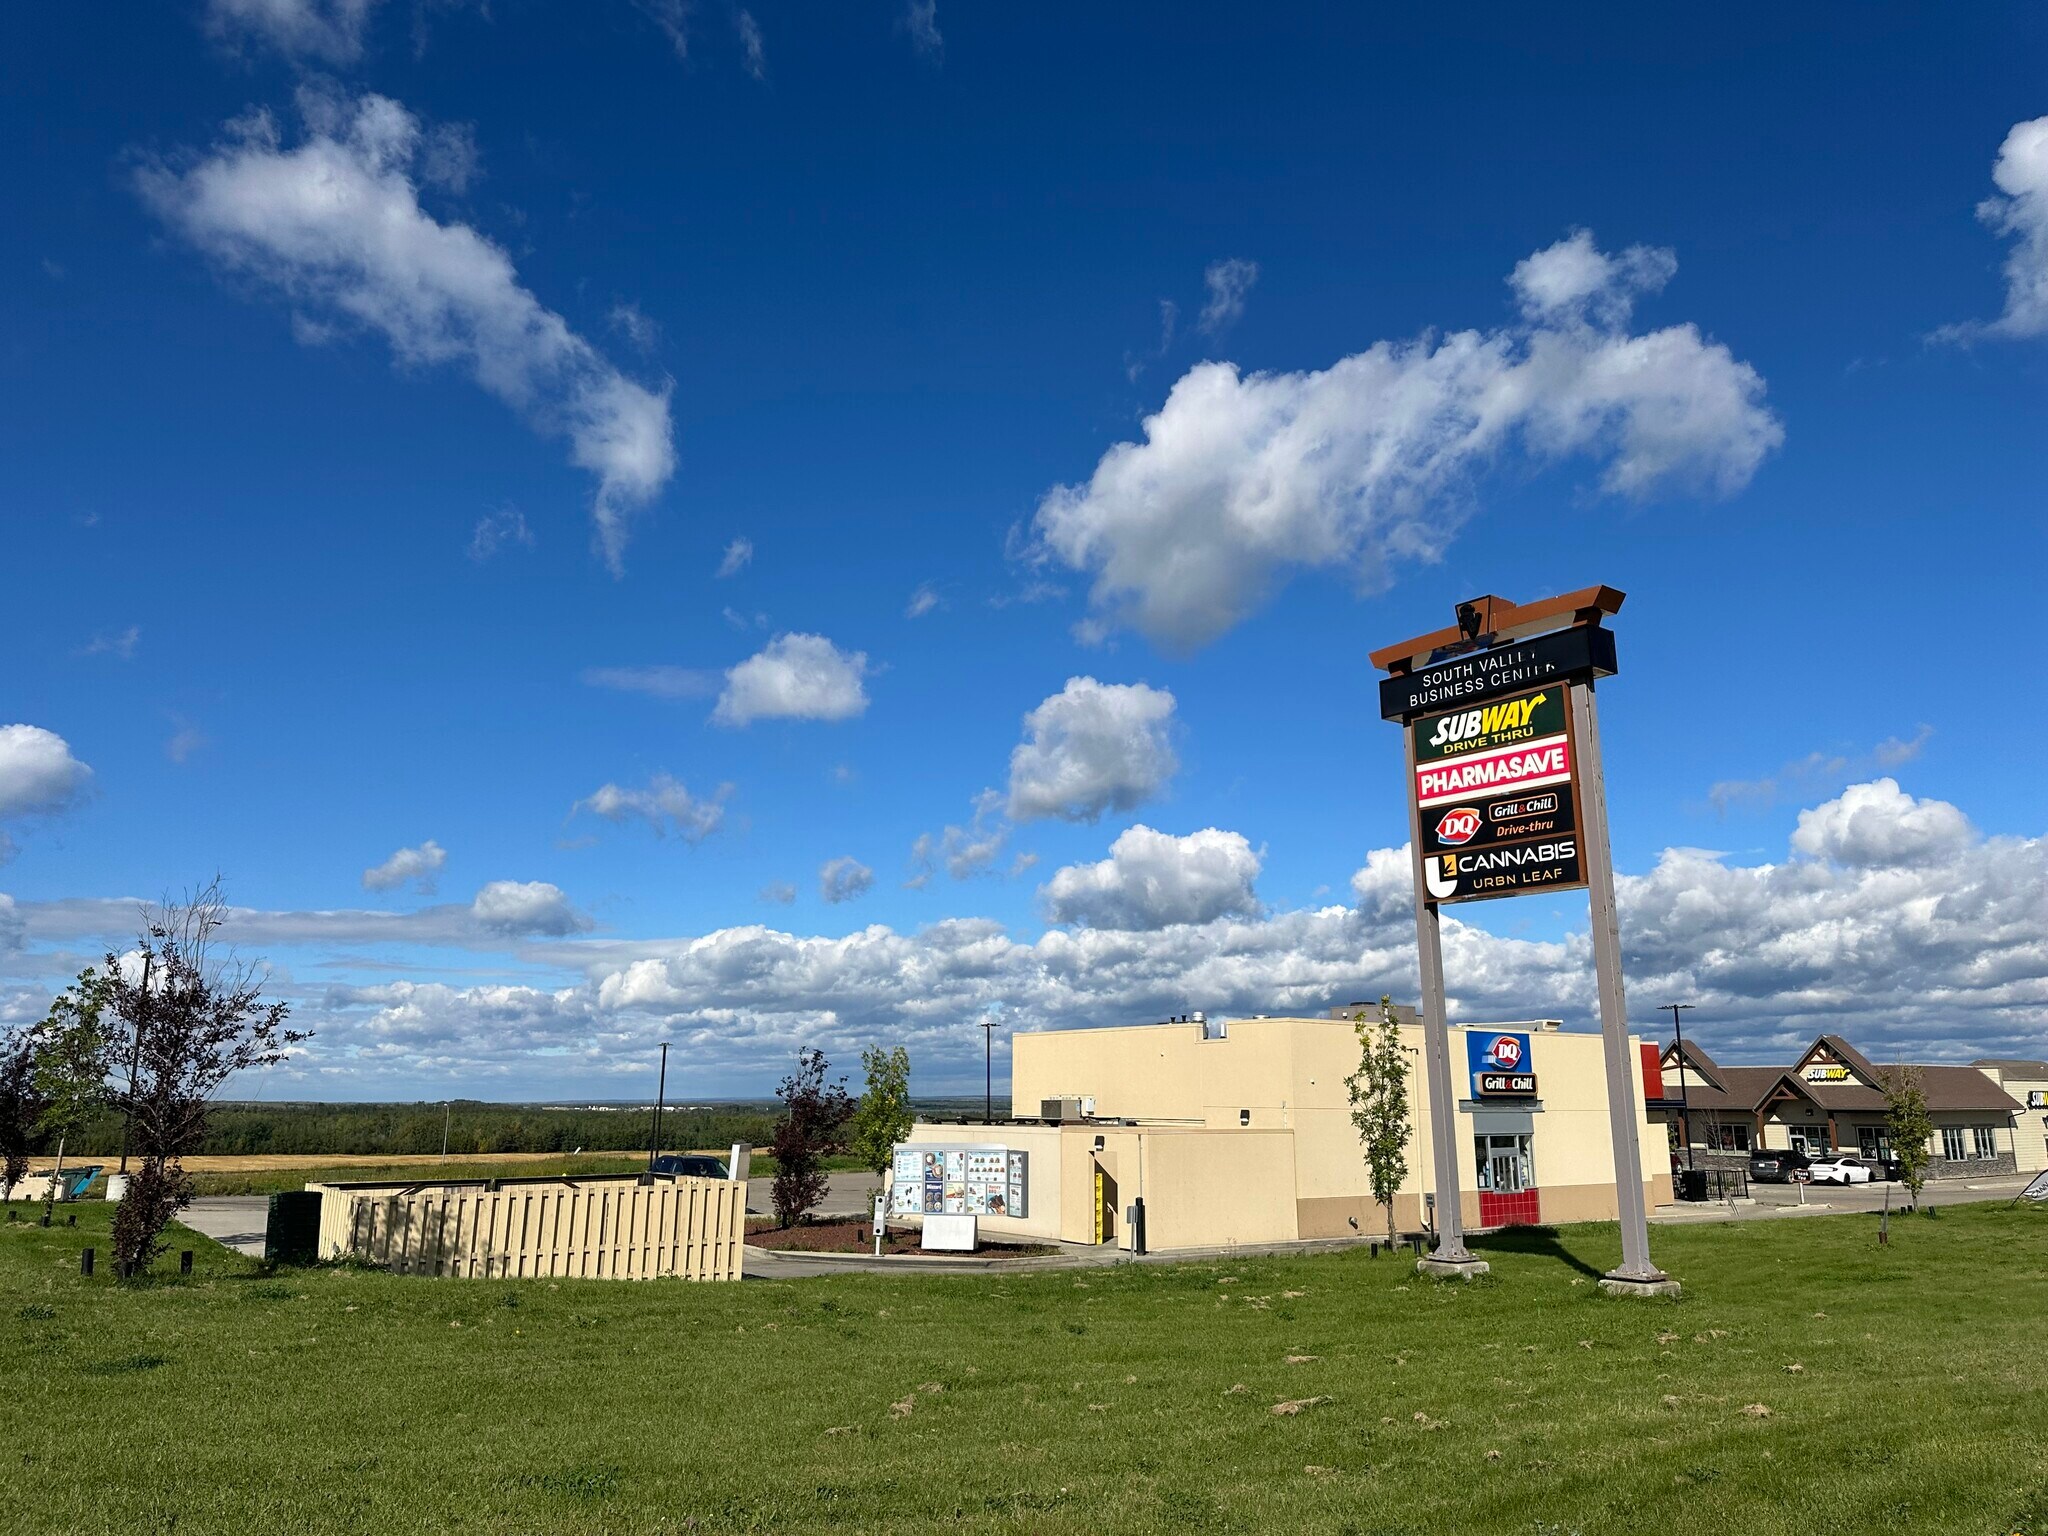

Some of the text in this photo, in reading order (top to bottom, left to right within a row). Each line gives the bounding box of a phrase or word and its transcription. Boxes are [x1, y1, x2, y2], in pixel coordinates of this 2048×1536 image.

[1422, 663, 1473, 687] SOUTH
[1409, 677, 1485, 707] BUSINESS
[1429, 692, 1547, 748] SUBWAY
[1443, 727, 1534, 754] DRIVE THRU
[1421, 747, 1565, 795] PHARMASAVE
[1444, 815, 1474, 836] DQ
[1496, 820, 1554, 837] Drive-thru
[1458, 841, 1576, 873] CANNABIS
[1473, 868, 1563, 889] URBN LEAF
[1498, 1043, 1518, 1061] DQ
[1808, 1068, 1851, 1080] SUBWAY
